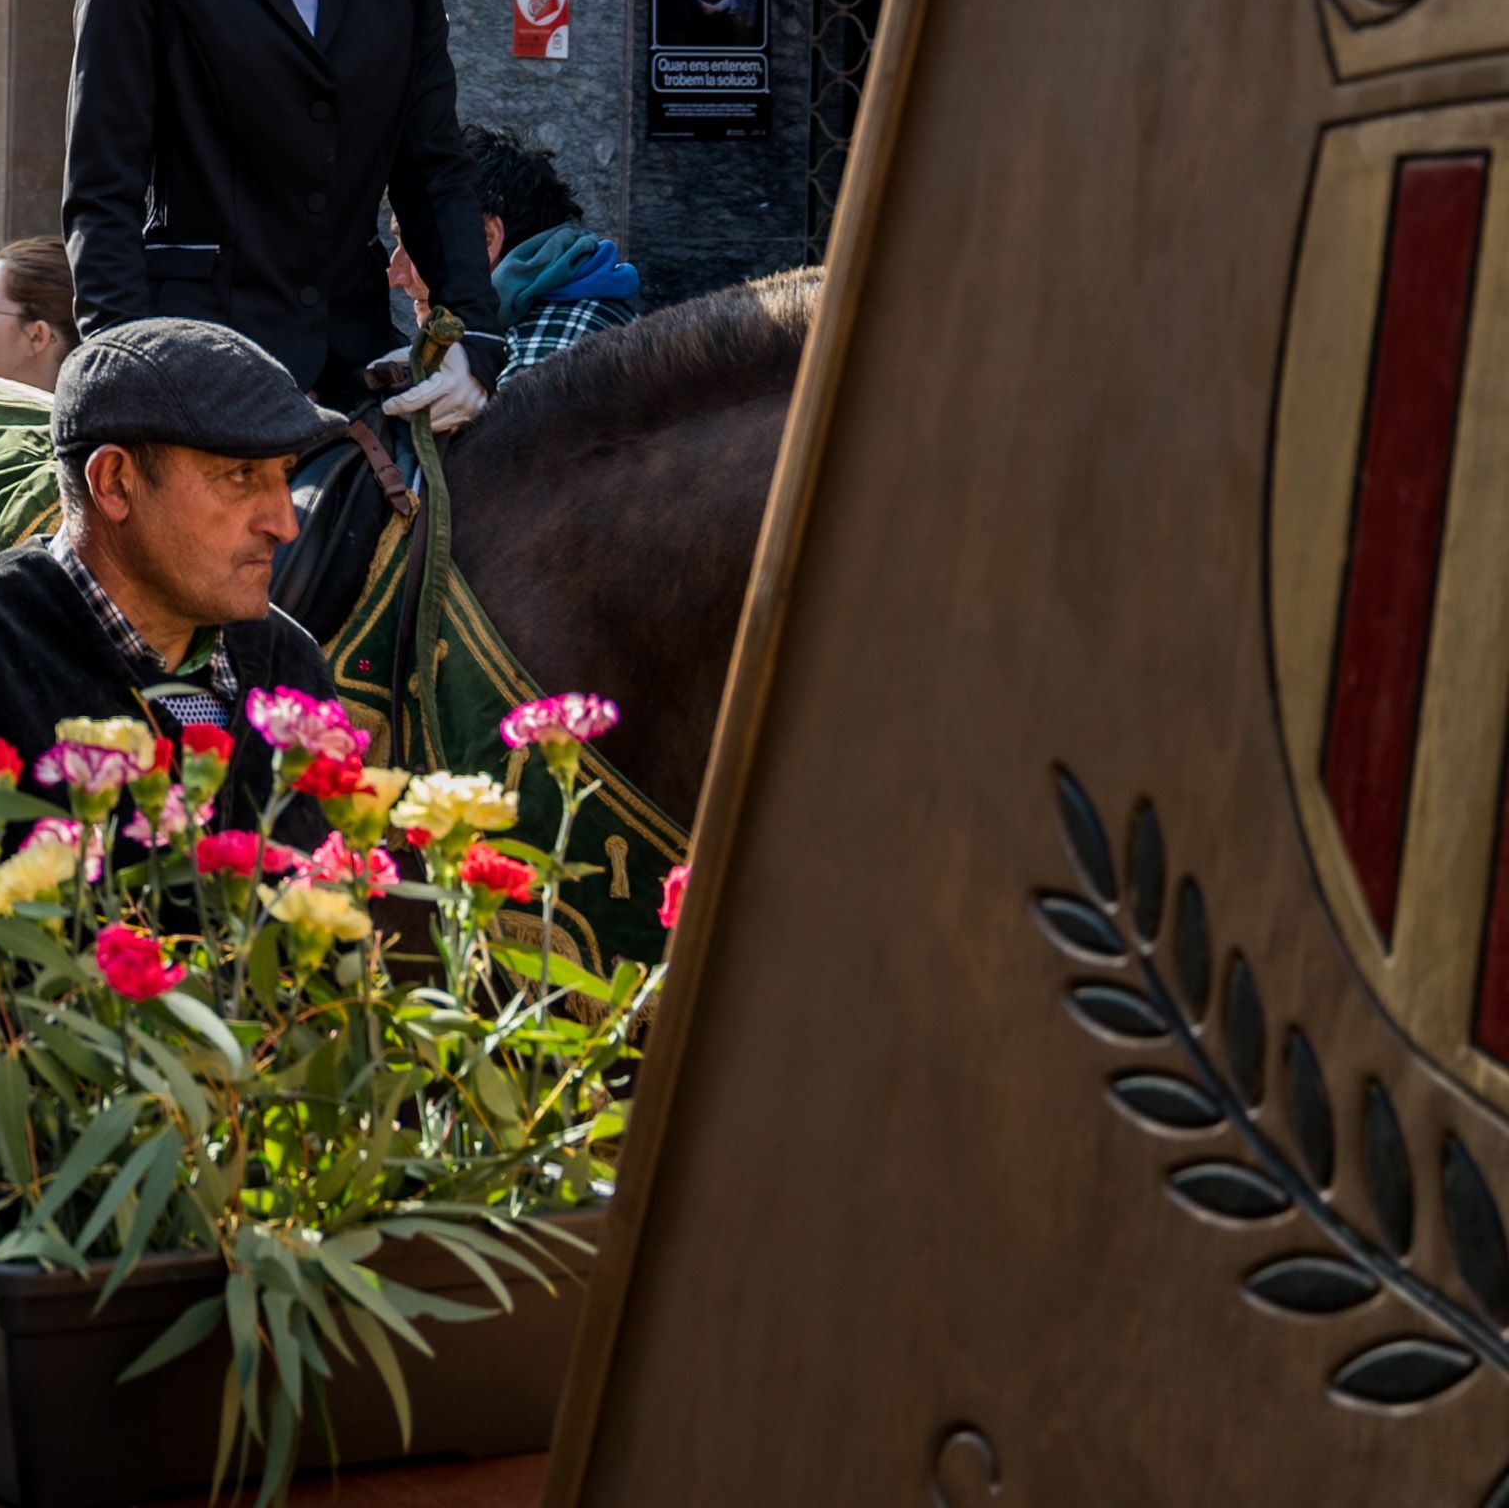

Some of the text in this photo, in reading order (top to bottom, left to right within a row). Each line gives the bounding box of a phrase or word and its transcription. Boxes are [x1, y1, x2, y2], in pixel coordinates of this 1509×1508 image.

[658, 58, 688, 72] Quan
[689, 61, 710, 72] ens
[664, 73, 758, 87] trobem la solució
